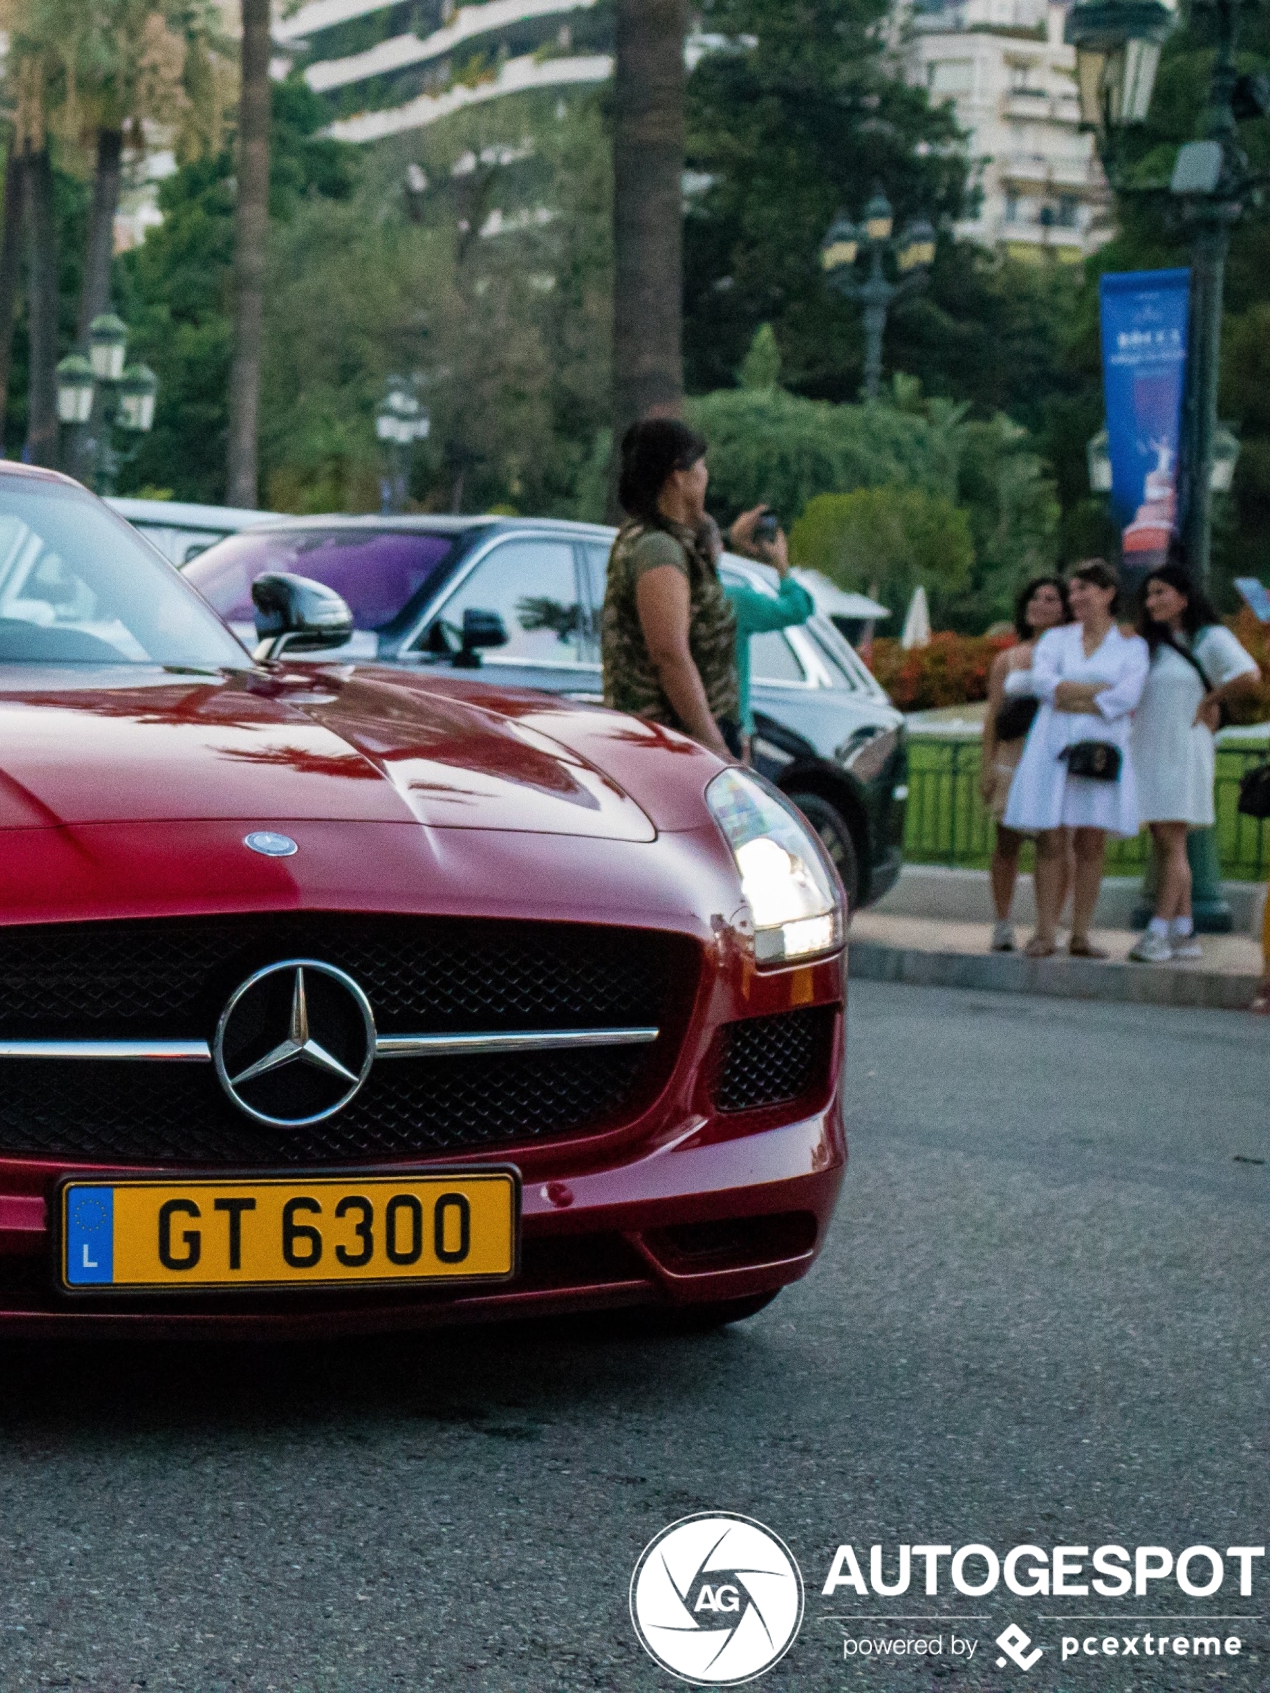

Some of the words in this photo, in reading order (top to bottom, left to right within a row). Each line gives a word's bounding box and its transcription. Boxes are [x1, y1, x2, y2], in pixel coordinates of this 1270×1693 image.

[83, 1244, 98, 1268] L
[158, 1197, 257, 1271] GT
[282, 1192, 471, 1269] 6300
